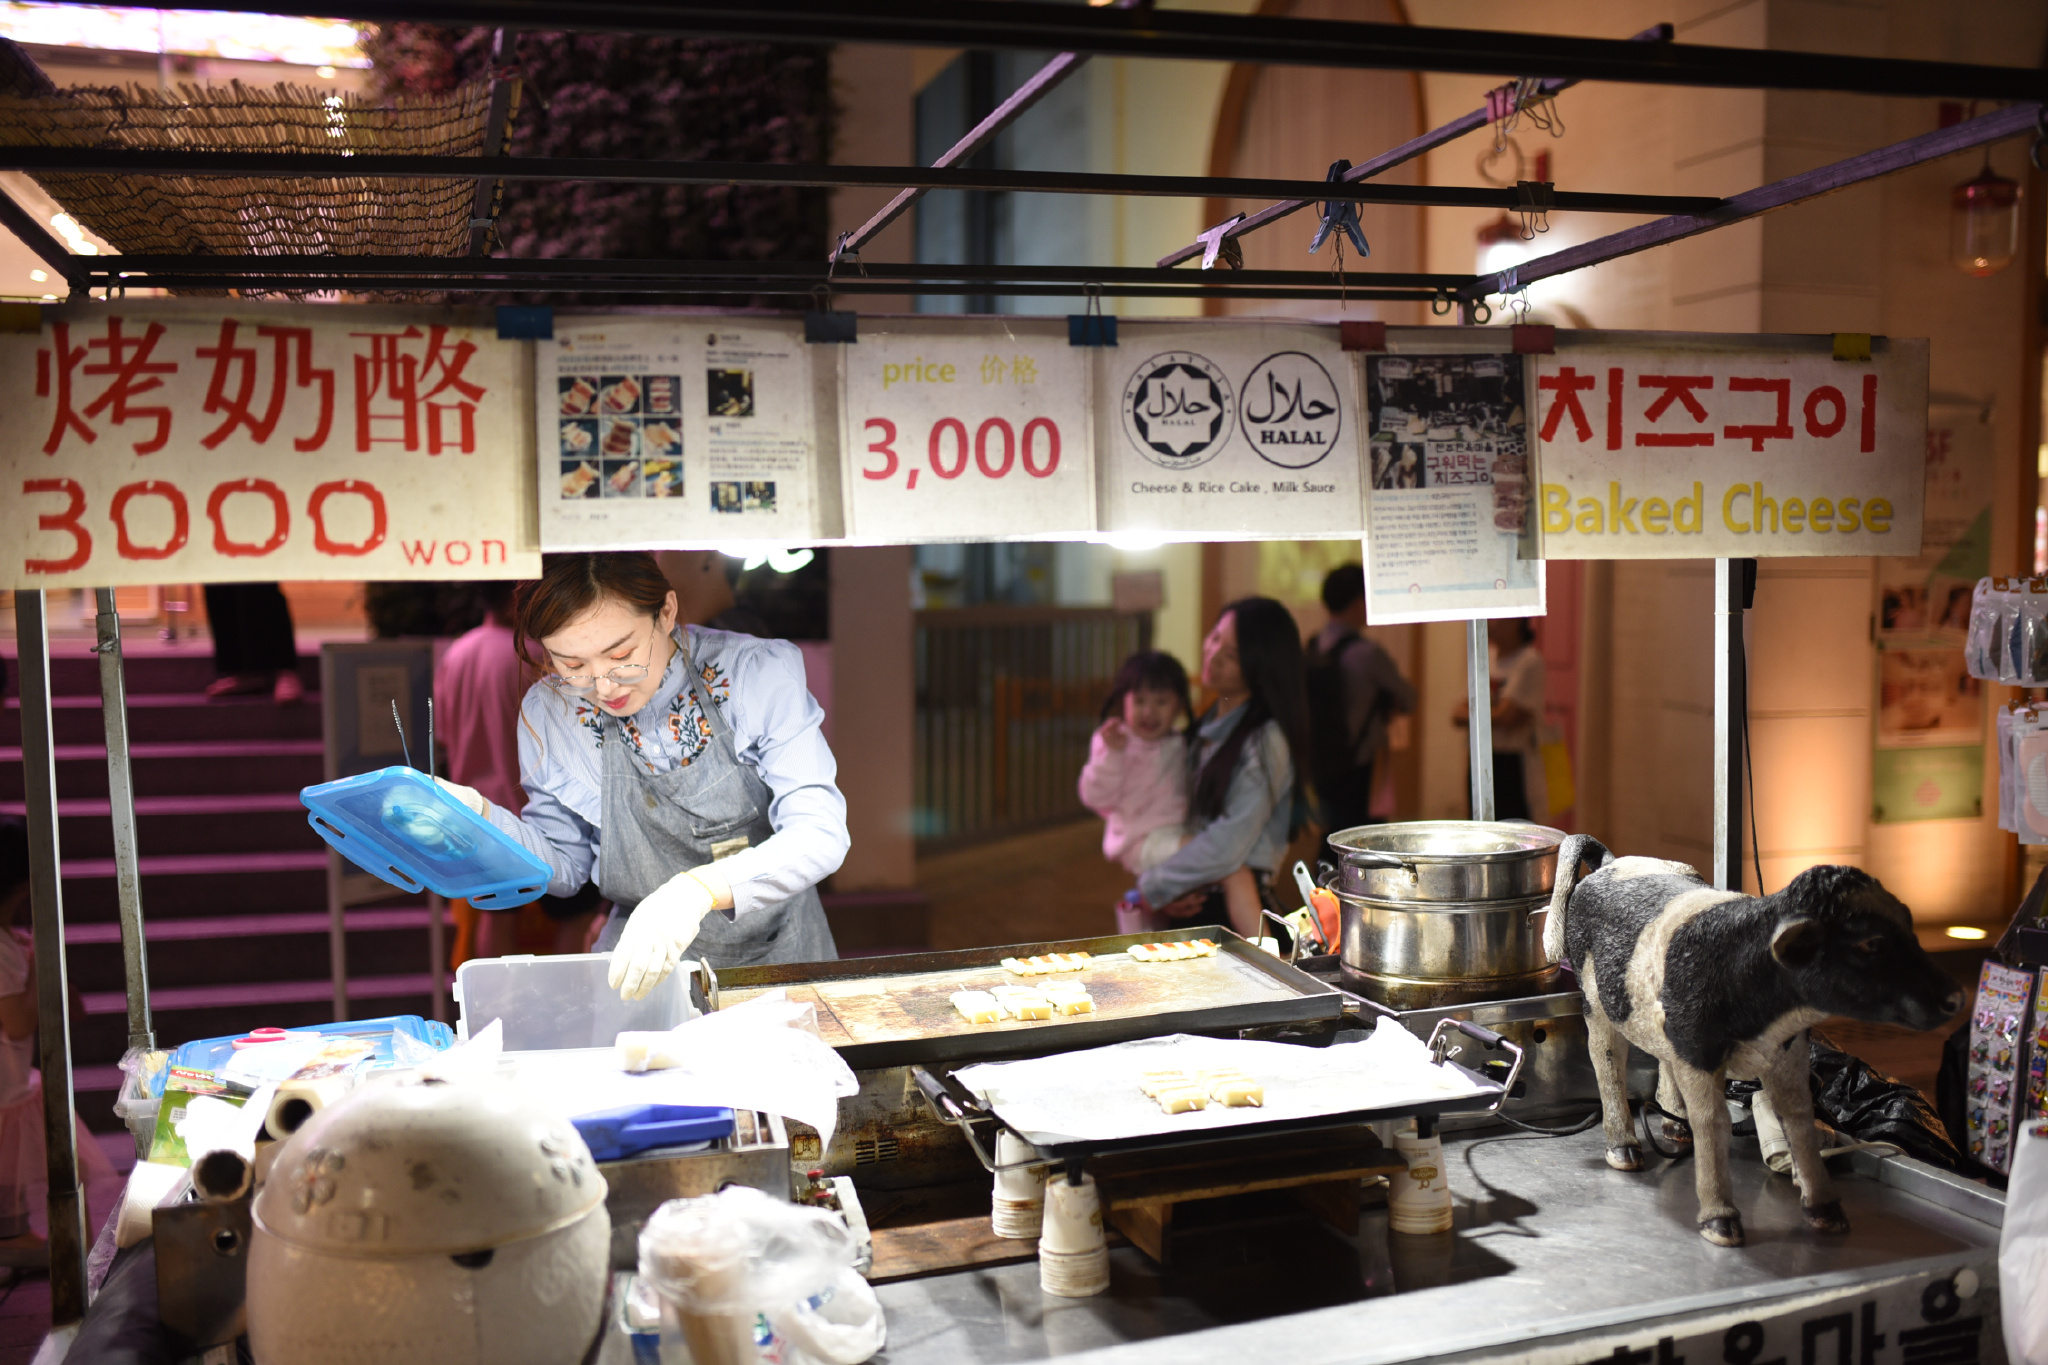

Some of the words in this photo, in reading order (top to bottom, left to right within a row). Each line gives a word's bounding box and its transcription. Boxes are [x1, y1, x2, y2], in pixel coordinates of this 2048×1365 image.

[36, 316, 487, 456] 烤奶酪
[883, 356, 957, 390] price
[979, 354, 1039, 385] 价格
[1246, 369, 1337, 424] حلال
[1147, 381, 1211, 418] حلال
[1538, 367, 1878, 453] 치즈구이
[863, 416, 1061, 489] 3,000
[1260, 430, 1327, 445] HALAL
[1427, 454, 1487, 471] 구워먹는
[1131, 481, 1178, 494] Cheese
[1182, 482, 1193, 494] &
[1199, 482, 1225, 494] Rice
[1229, 481, 1261, 494] Cake
[1272, 481, 1299, 494] Milk
[1302, 481, 1337, 494] Sauce
[1541, 481, 1703, 534] Baked
[1722, 481, 1894, 534] Cheese
[23, 478, 388, 575] 3000
[401, 539, 507, 566] won
